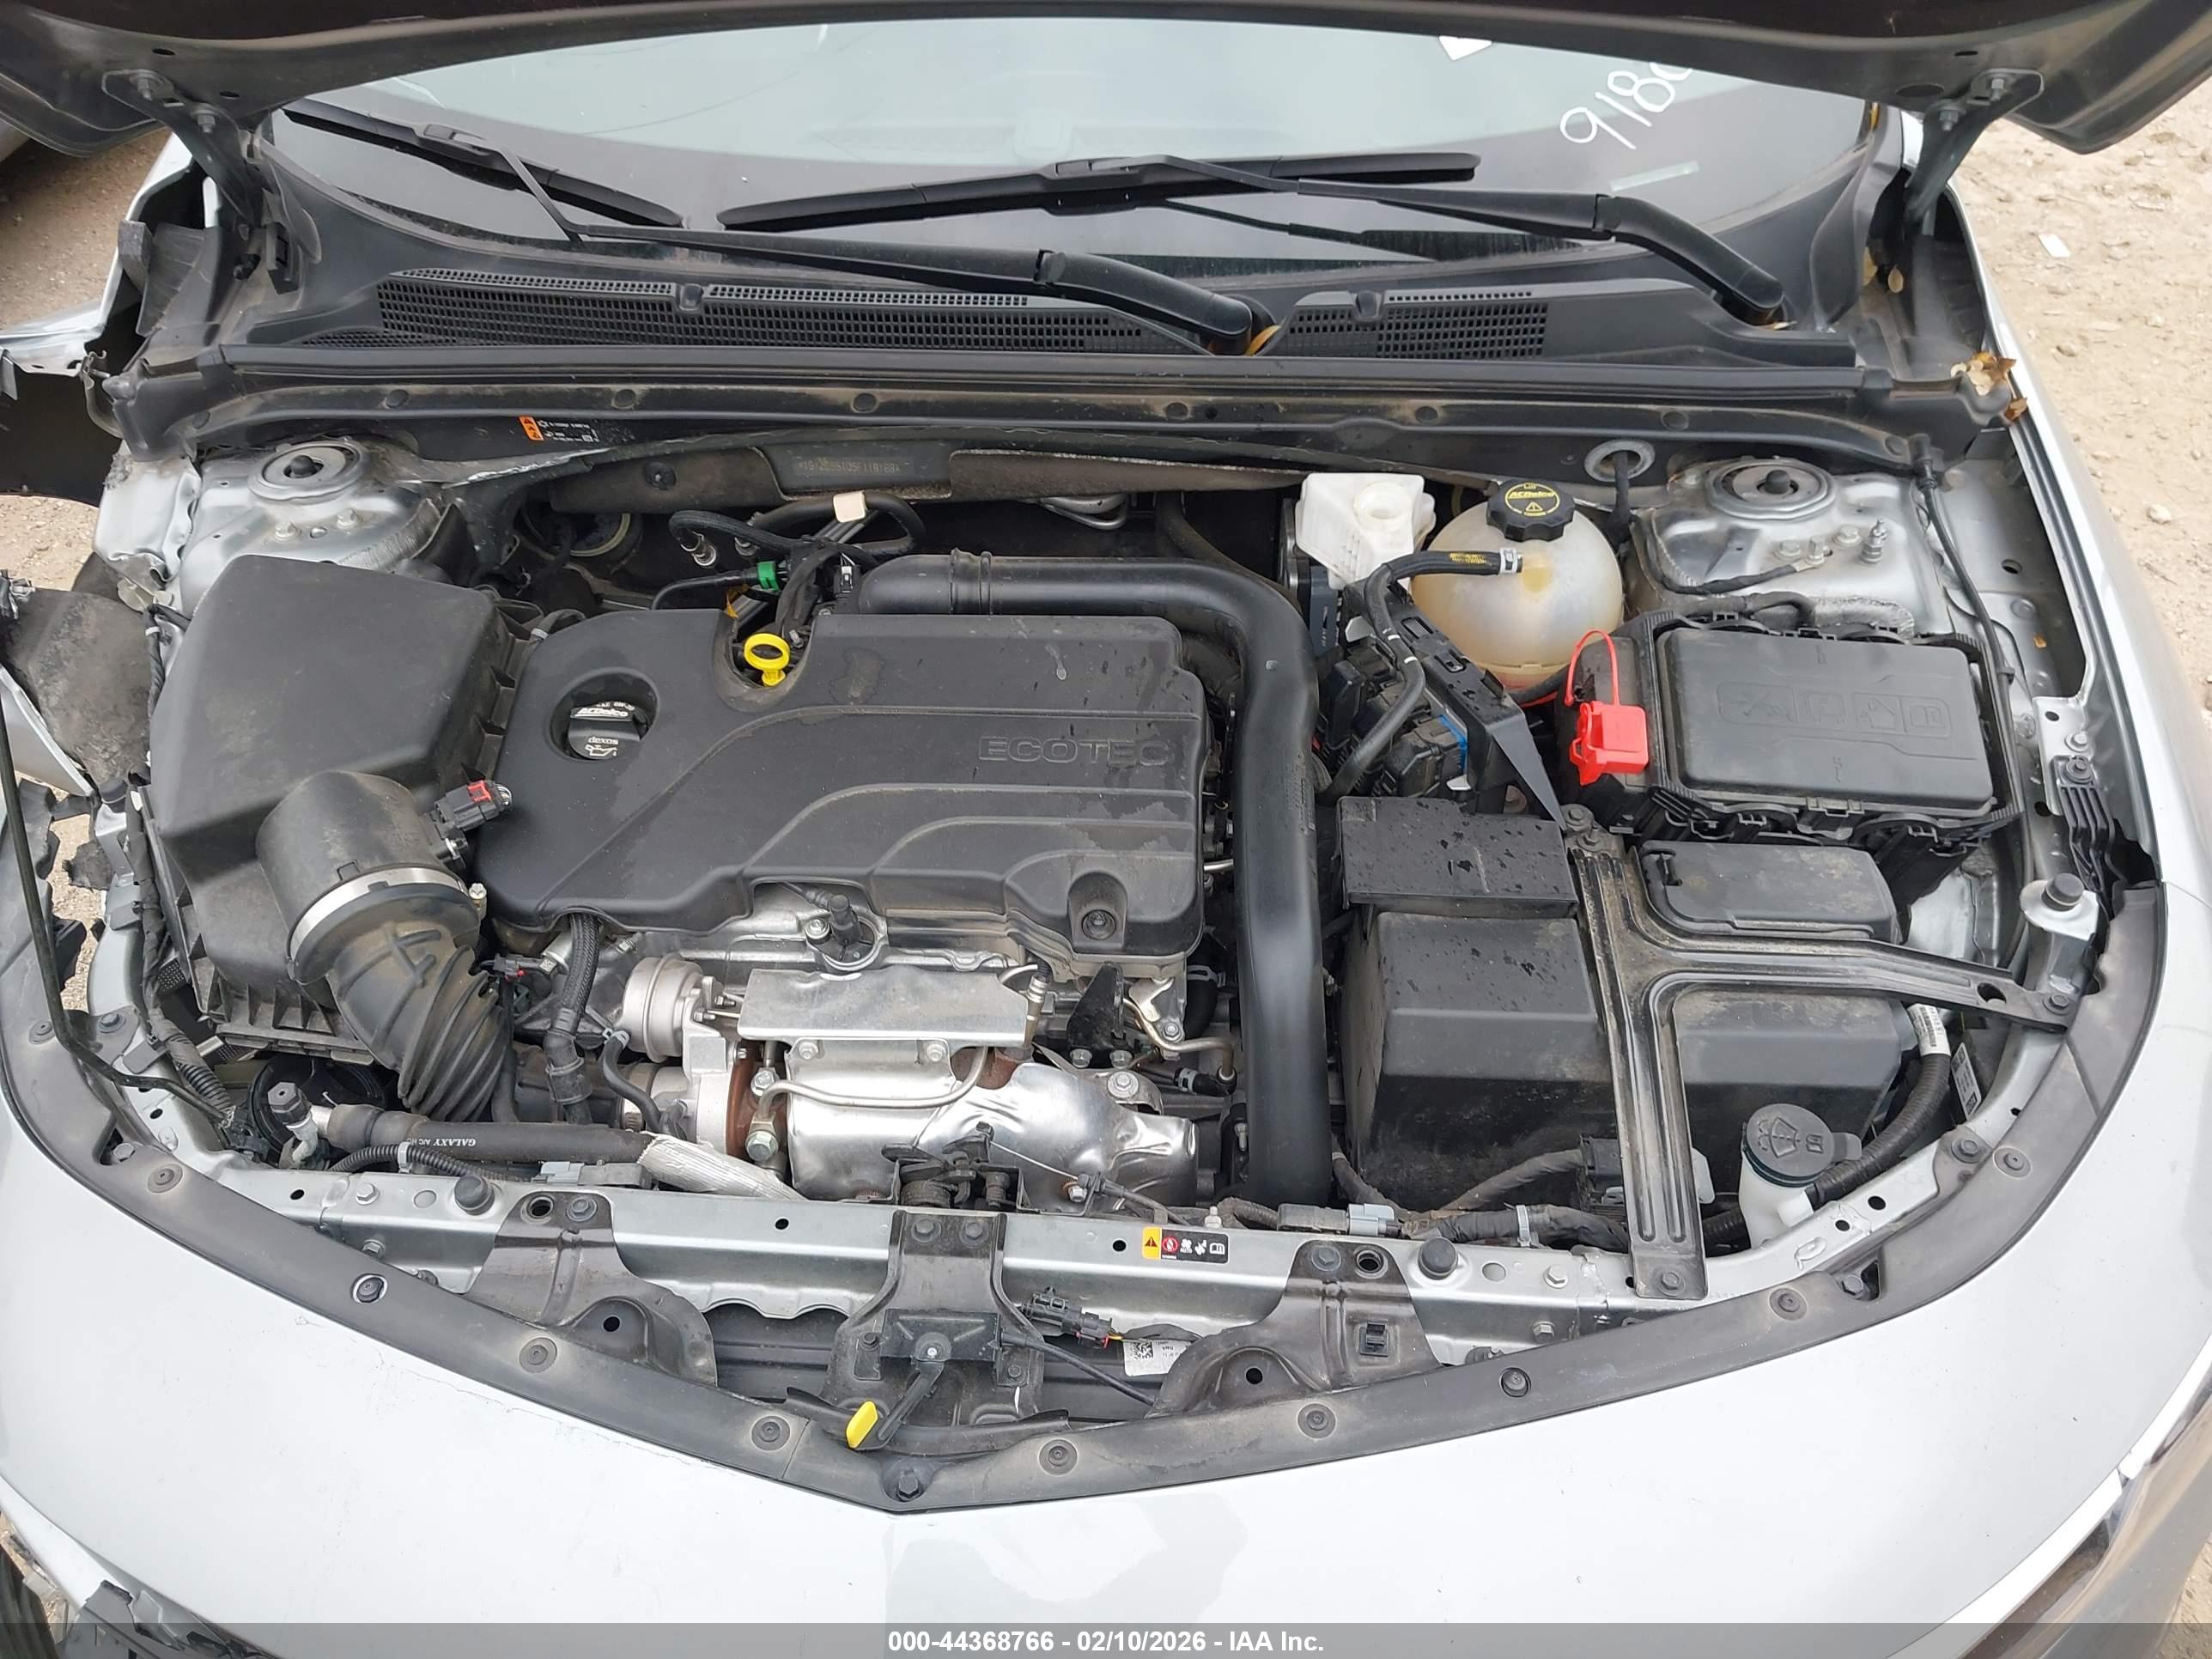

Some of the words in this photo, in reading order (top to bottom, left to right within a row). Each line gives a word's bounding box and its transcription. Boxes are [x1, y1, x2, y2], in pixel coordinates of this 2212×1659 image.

[588, 736, 618, 745] dexos
[979, 736, 1170, 766] ECOTEC
[433, 1138, 476, 1147] GALAXY
